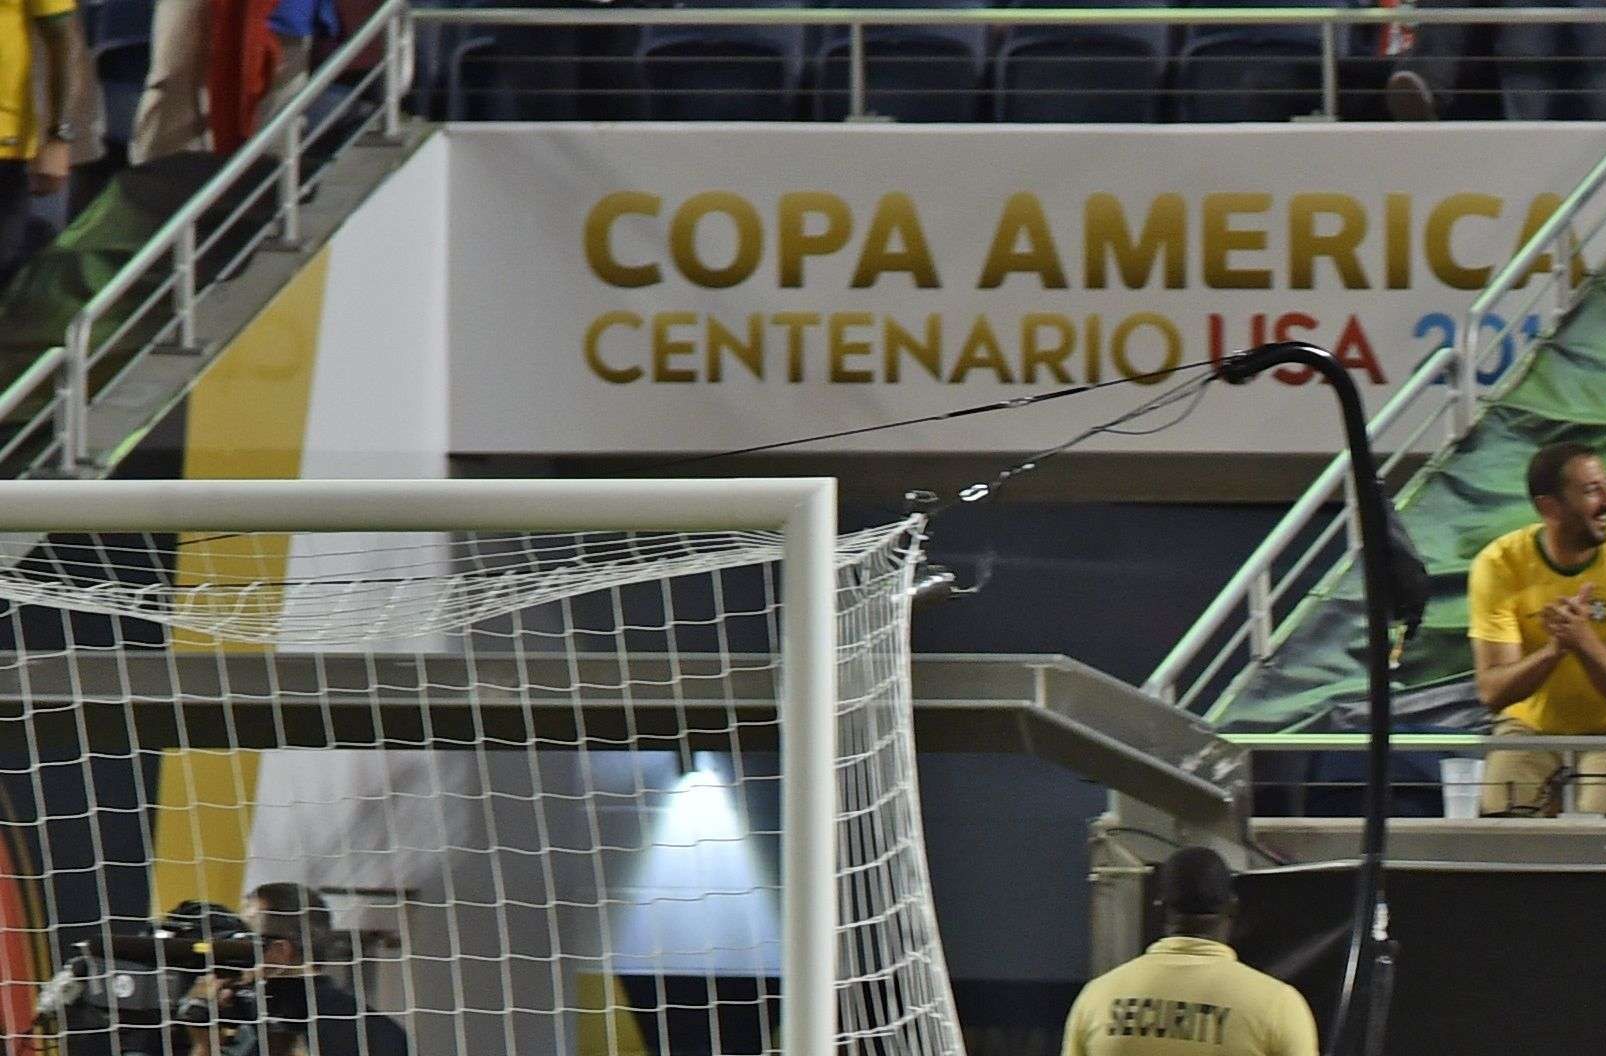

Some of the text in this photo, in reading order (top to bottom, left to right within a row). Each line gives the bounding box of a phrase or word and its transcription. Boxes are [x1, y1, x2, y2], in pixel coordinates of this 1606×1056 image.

[583, 190, 1588, 291] COPA AMERICA
[583, 311, 1182, 385] CENTENARIO
[1209, 312, 1389, 386] USA
[1107, 998, 1232, 1045] SECURITY
